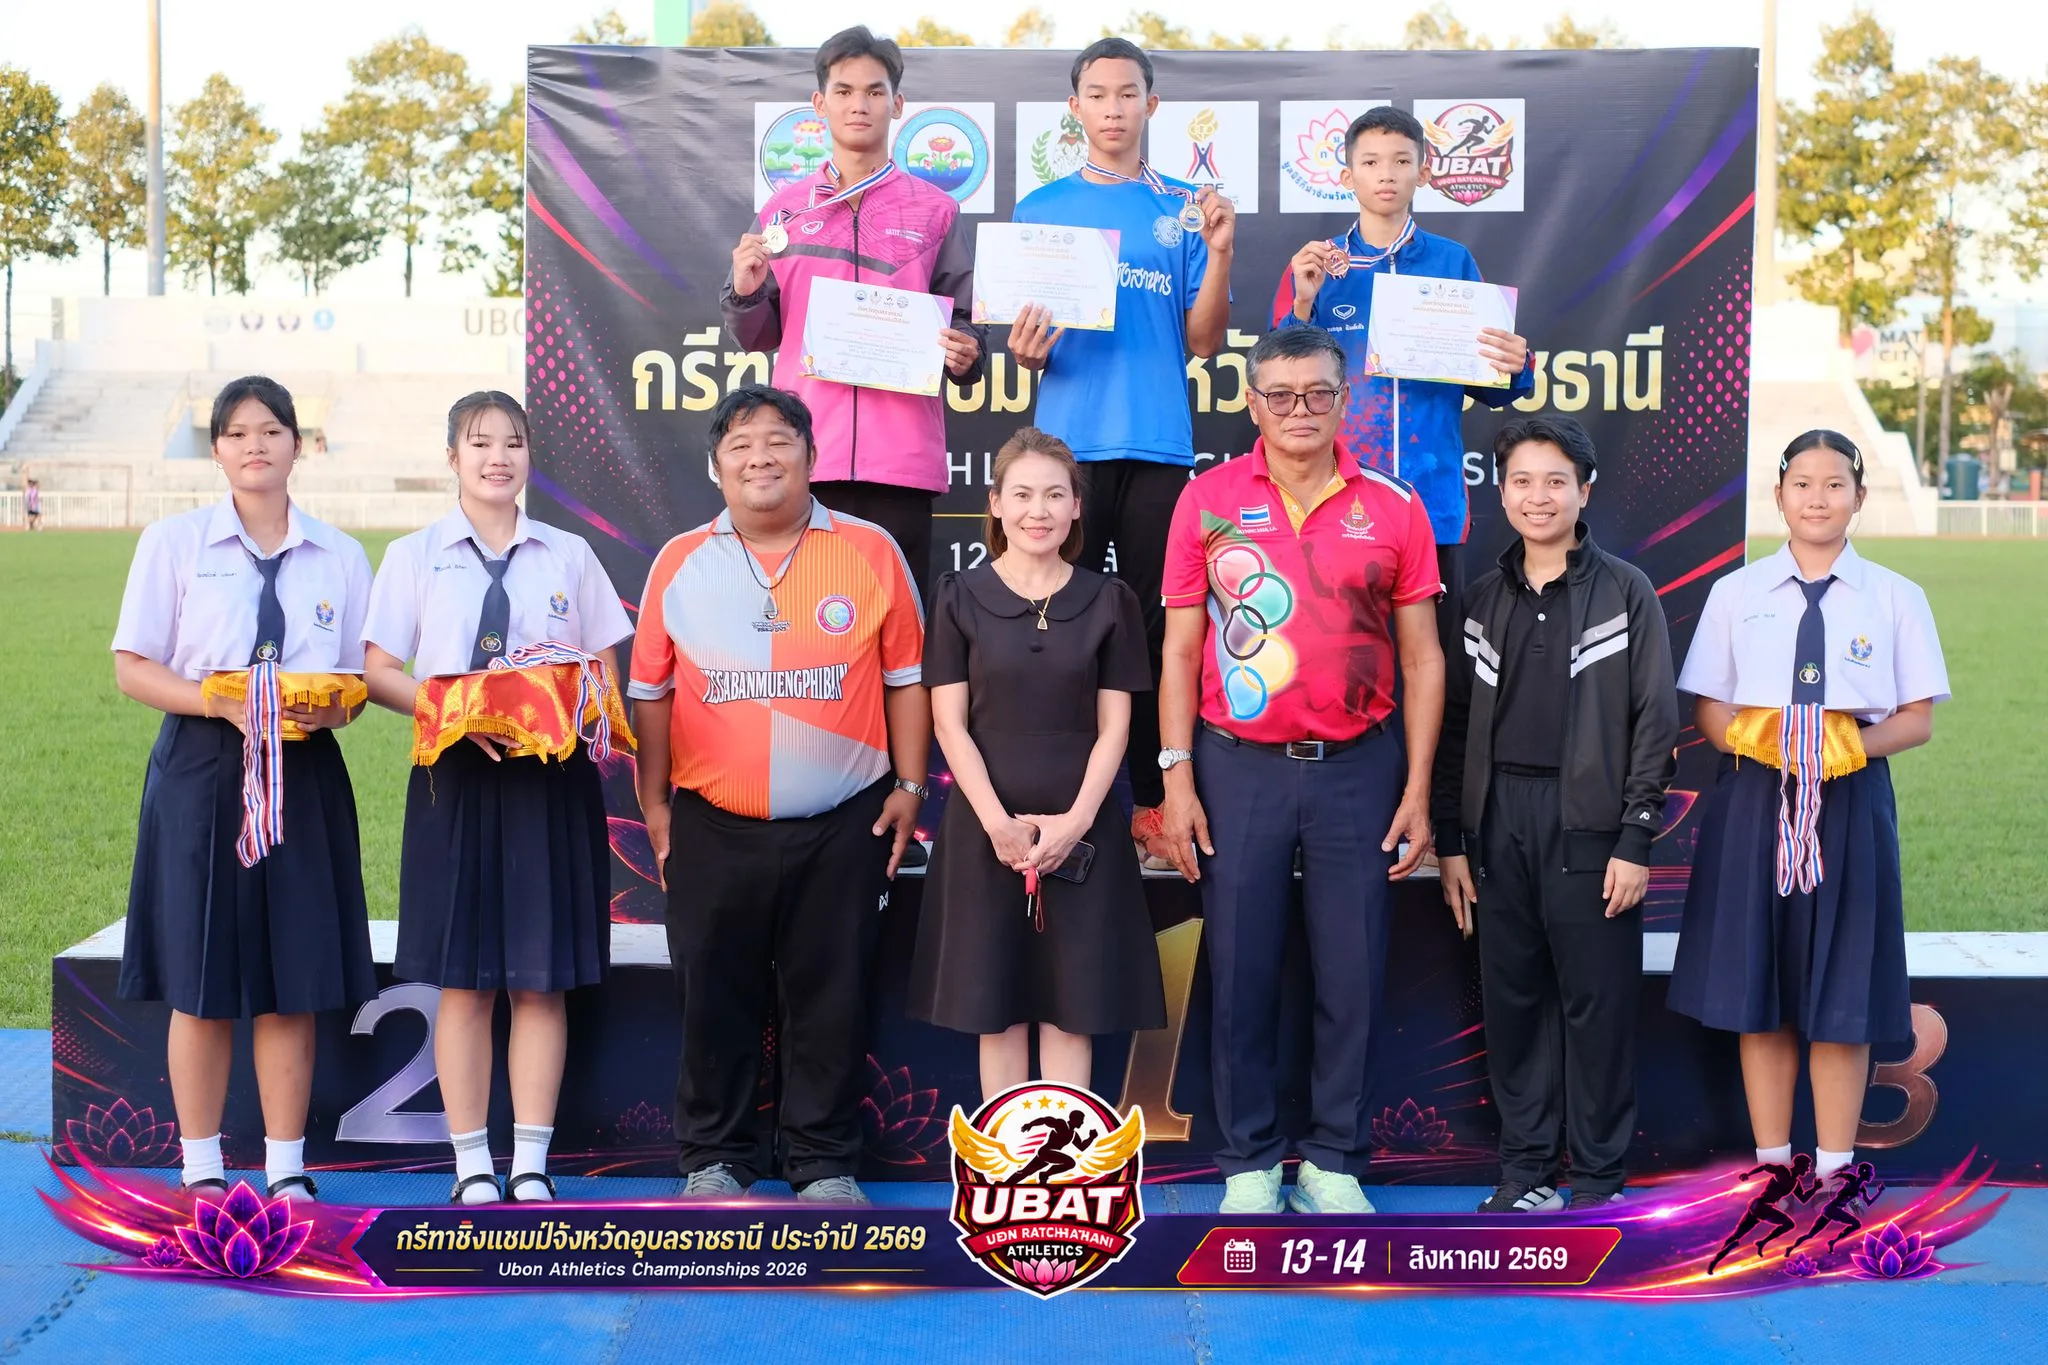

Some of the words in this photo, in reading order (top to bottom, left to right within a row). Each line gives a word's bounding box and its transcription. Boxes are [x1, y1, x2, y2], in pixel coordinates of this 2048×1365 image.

[1431, 156, 1507, 177] UBAT
[335, 982, 453, 1144] 2
[1114, 918, 1204, 1141] 1
